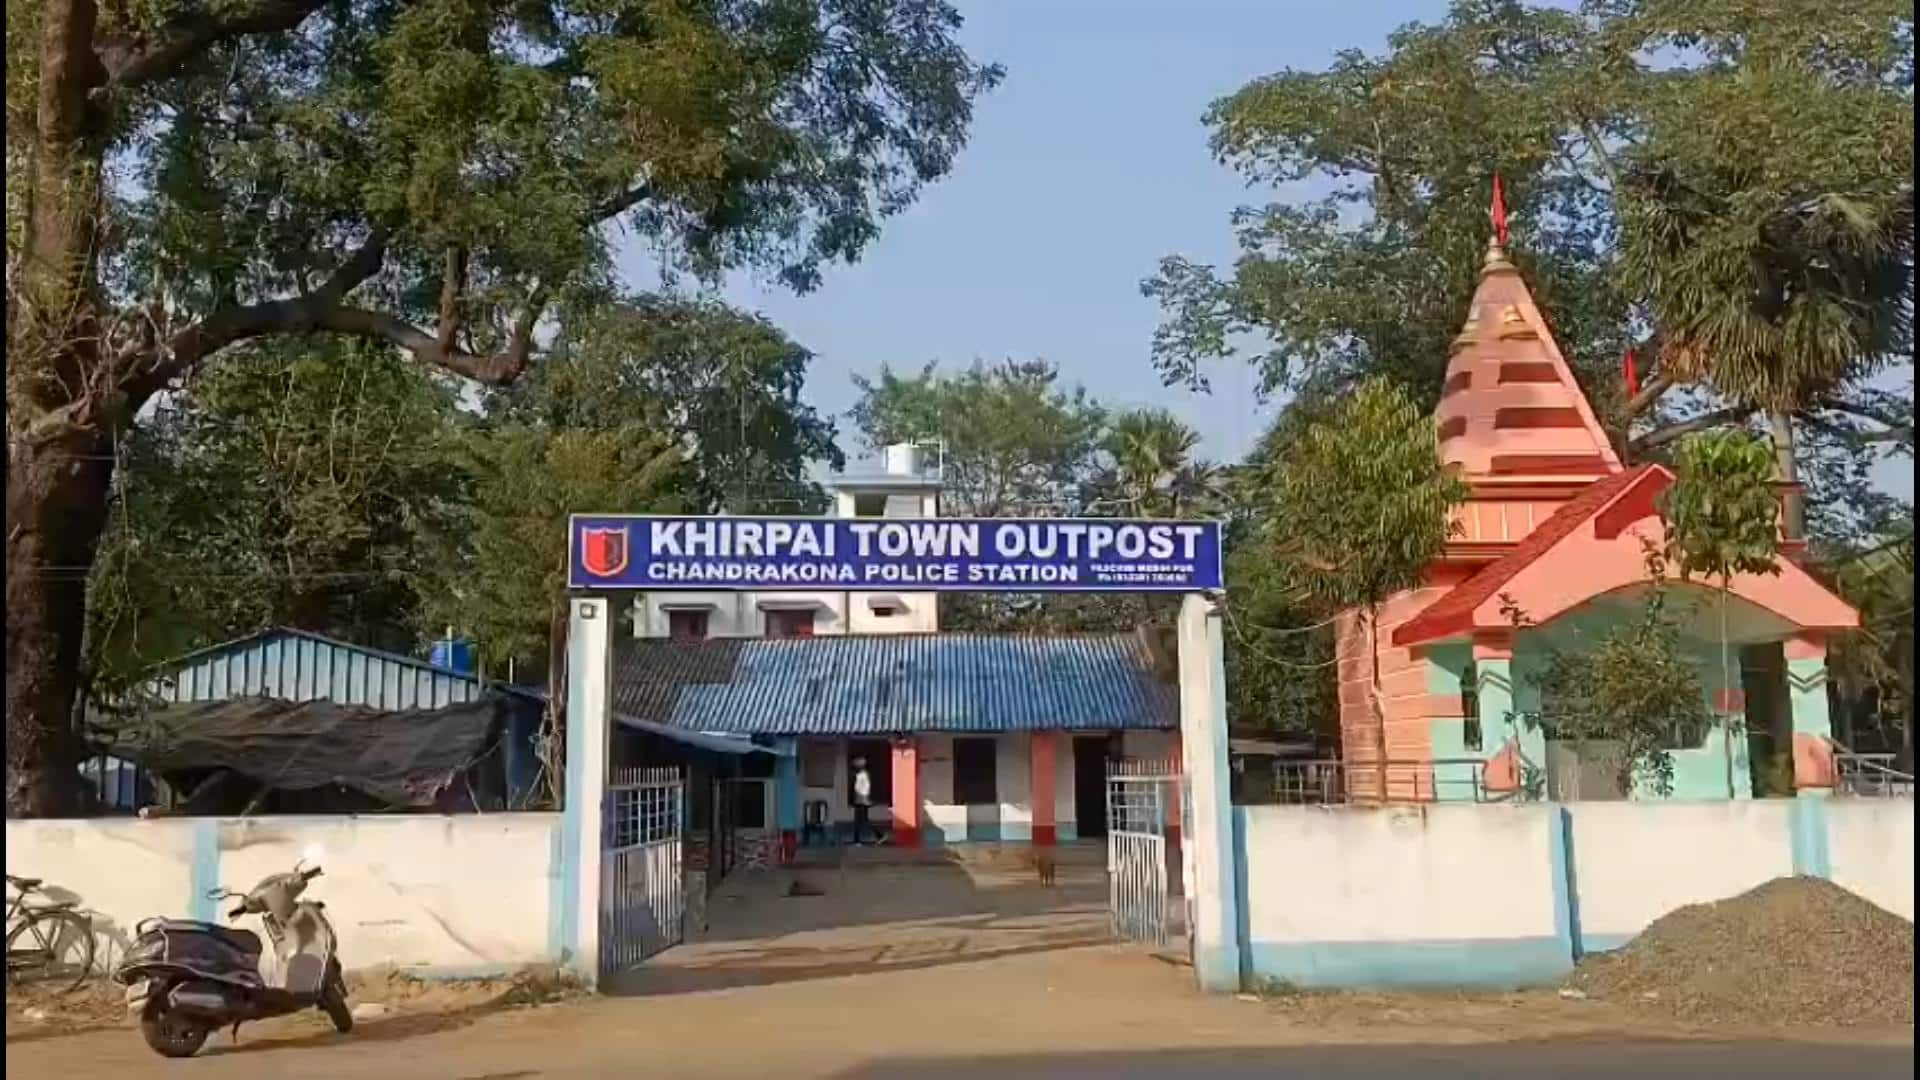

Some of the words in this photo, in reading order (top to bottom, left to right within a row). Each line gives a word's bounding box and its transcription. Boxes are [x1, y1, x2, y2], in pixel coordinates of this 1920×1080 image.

[651, 522, 834, 557] KHIRPAI
[849, 522, 978, 557] TOWN
[996, 523, 1203, 558] OUTPOST
[648, 564, 855, 581] CHANDRAKONA
[865, 564, 957, 581] POLICE
[968, 564, 1077, 582] STATION
